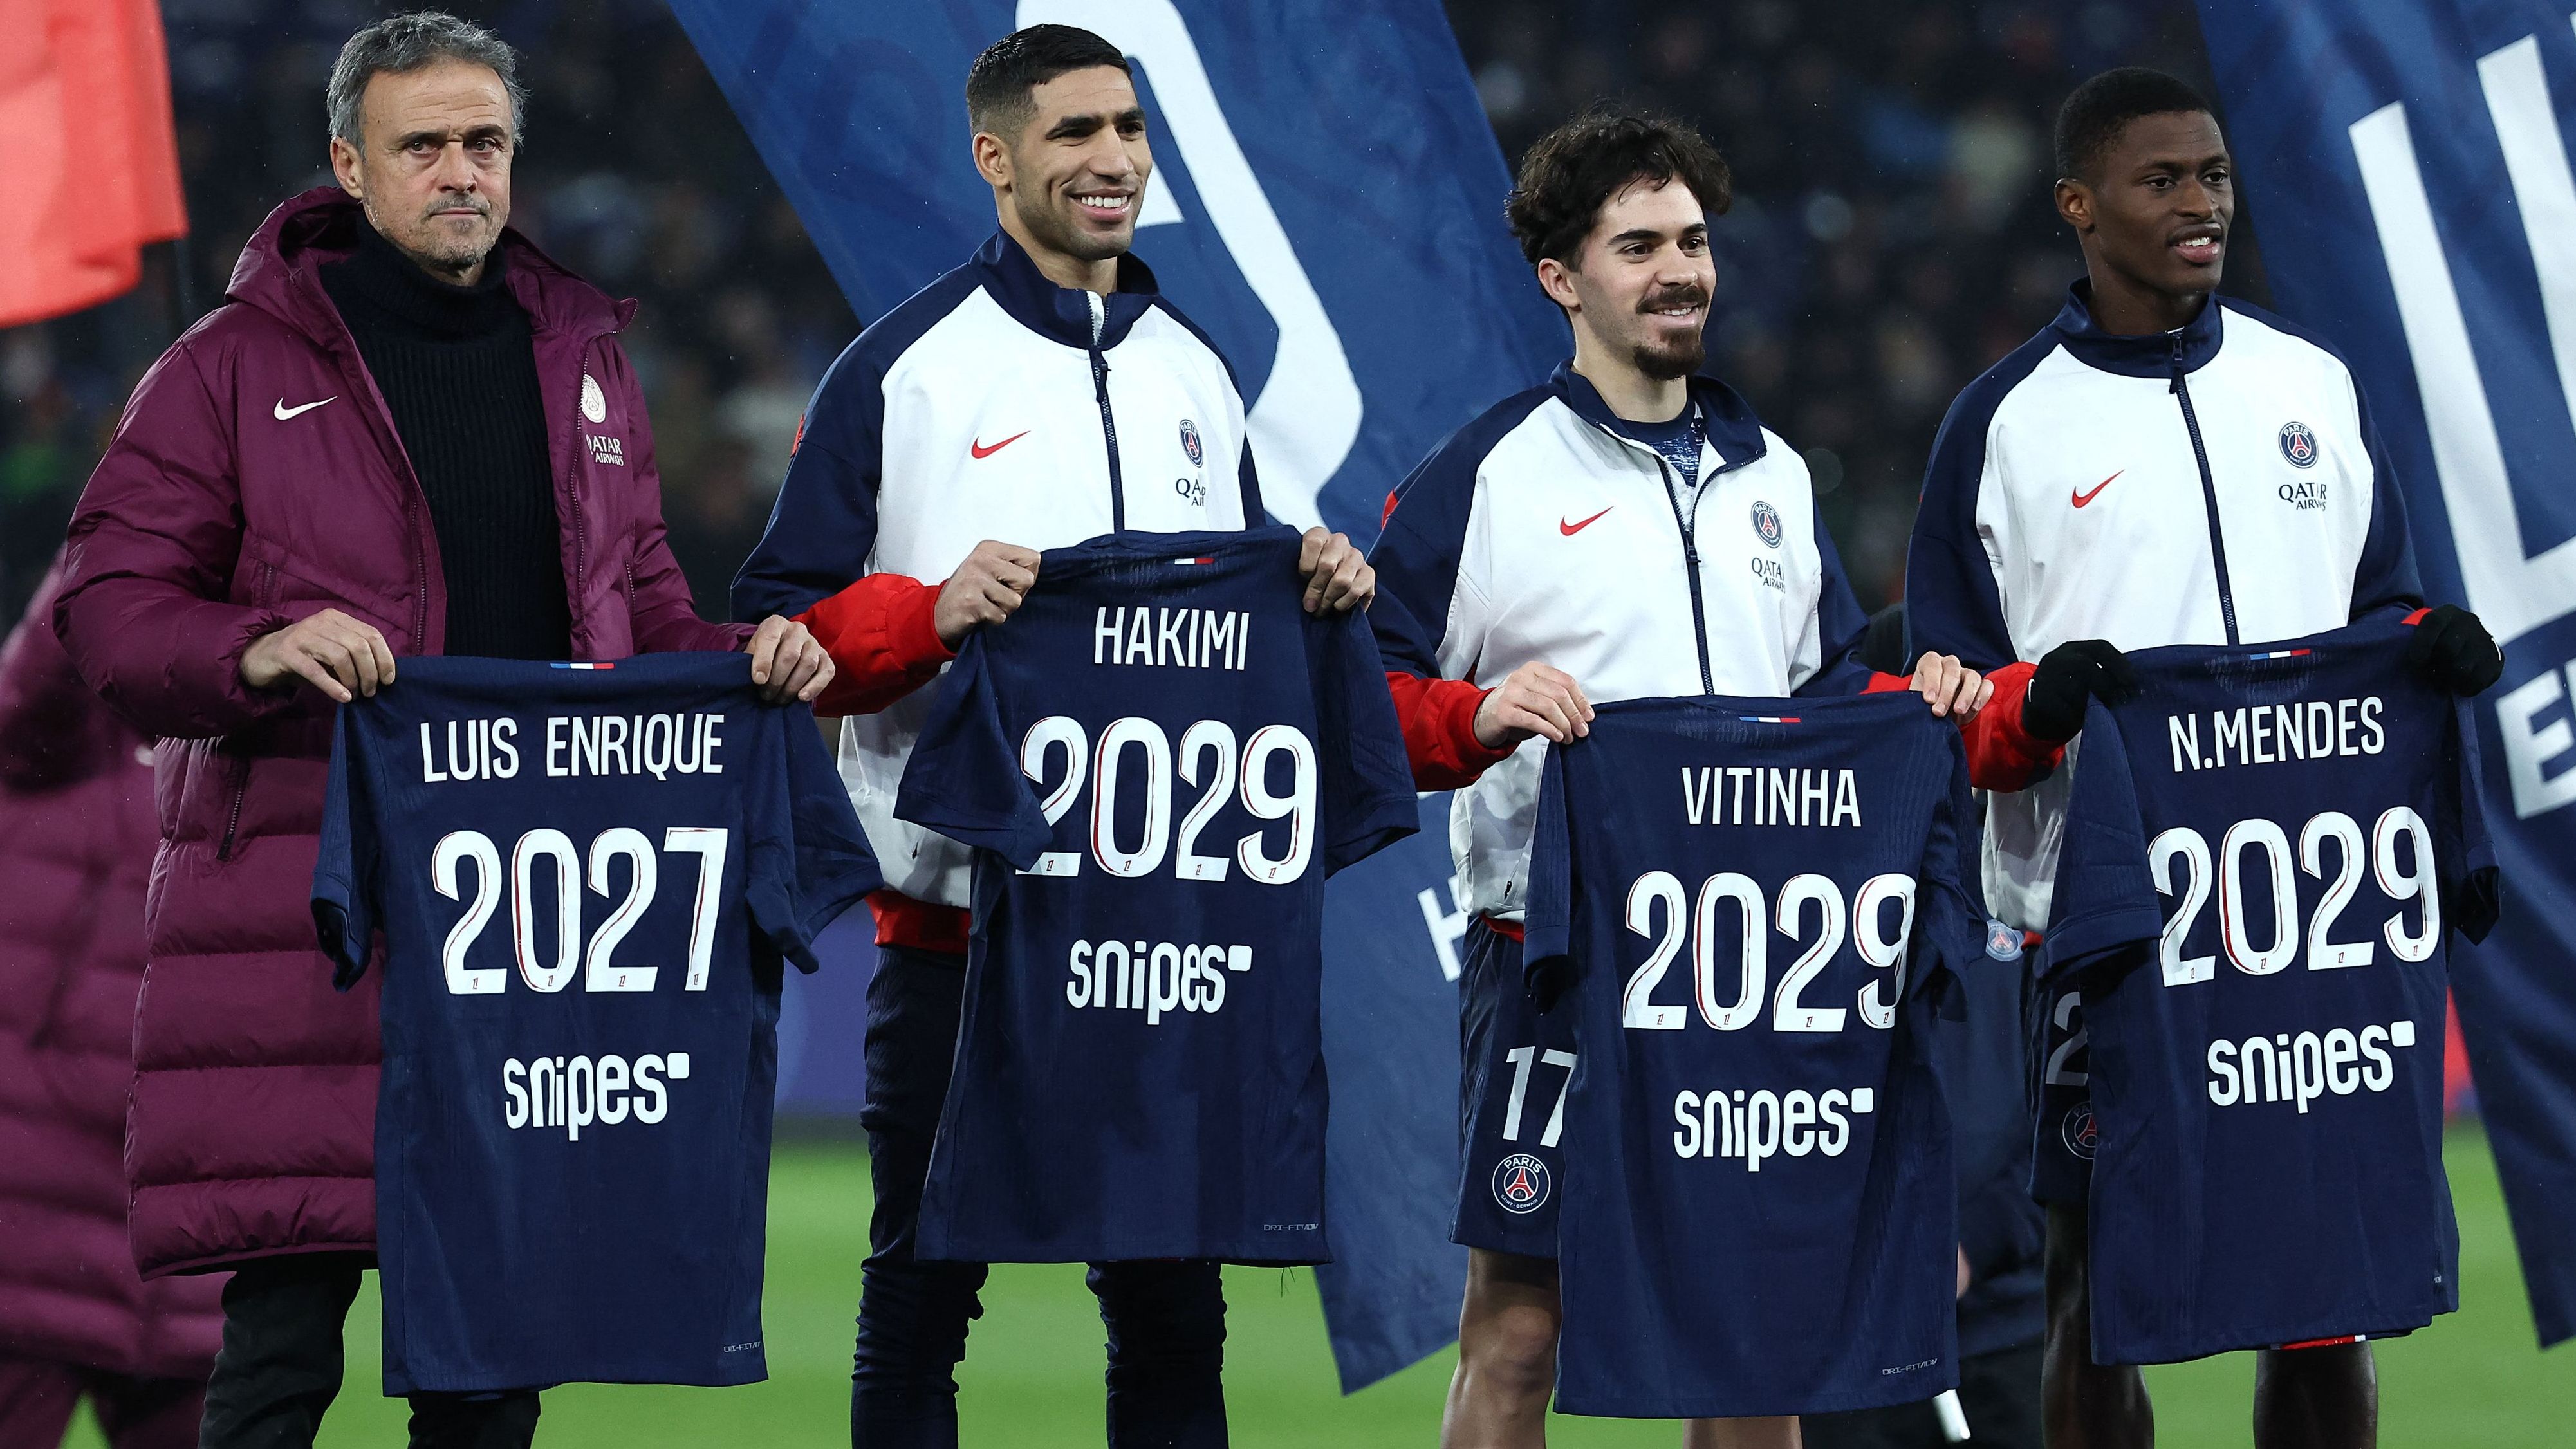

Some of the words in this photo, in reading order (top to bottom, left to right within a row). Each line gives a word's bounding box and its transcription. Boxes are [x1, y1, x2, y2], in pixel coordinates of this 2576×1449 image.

[2283, 425, 2309, 436] PARIS
[1755, 504, 1775, 517] PARIS
[2279, 483, 2327, 503] QATR
[1752, 557, 1784, 581] QATA
[1095, 607, 1250, 670] HAKIMI
[420, 717, 519, 783] LUIS
[546, 713, 725, 781] ENRIQUE
[2169, 696, 2384, 773] N.MENDES
[1015, 715, 1317, 885] 2029
[1682, 767, 1862, 827] VITINHA
[431, 827, 728, 995] 2027
[2147, 806, 2440, 988] 2029
[1066, 939, 1227, 1026] snipes
[1622, 871, 1917, 1032] 2029
[503, 1053, 667, 1141] snipes
[1502, 1046, 1577, 1148] 17
[2207, 1024, 2393, 1114] snipes
[1503, 1156, 1543, 1174] PARIS
[1674, 1089, 1849, 1172] snipes
